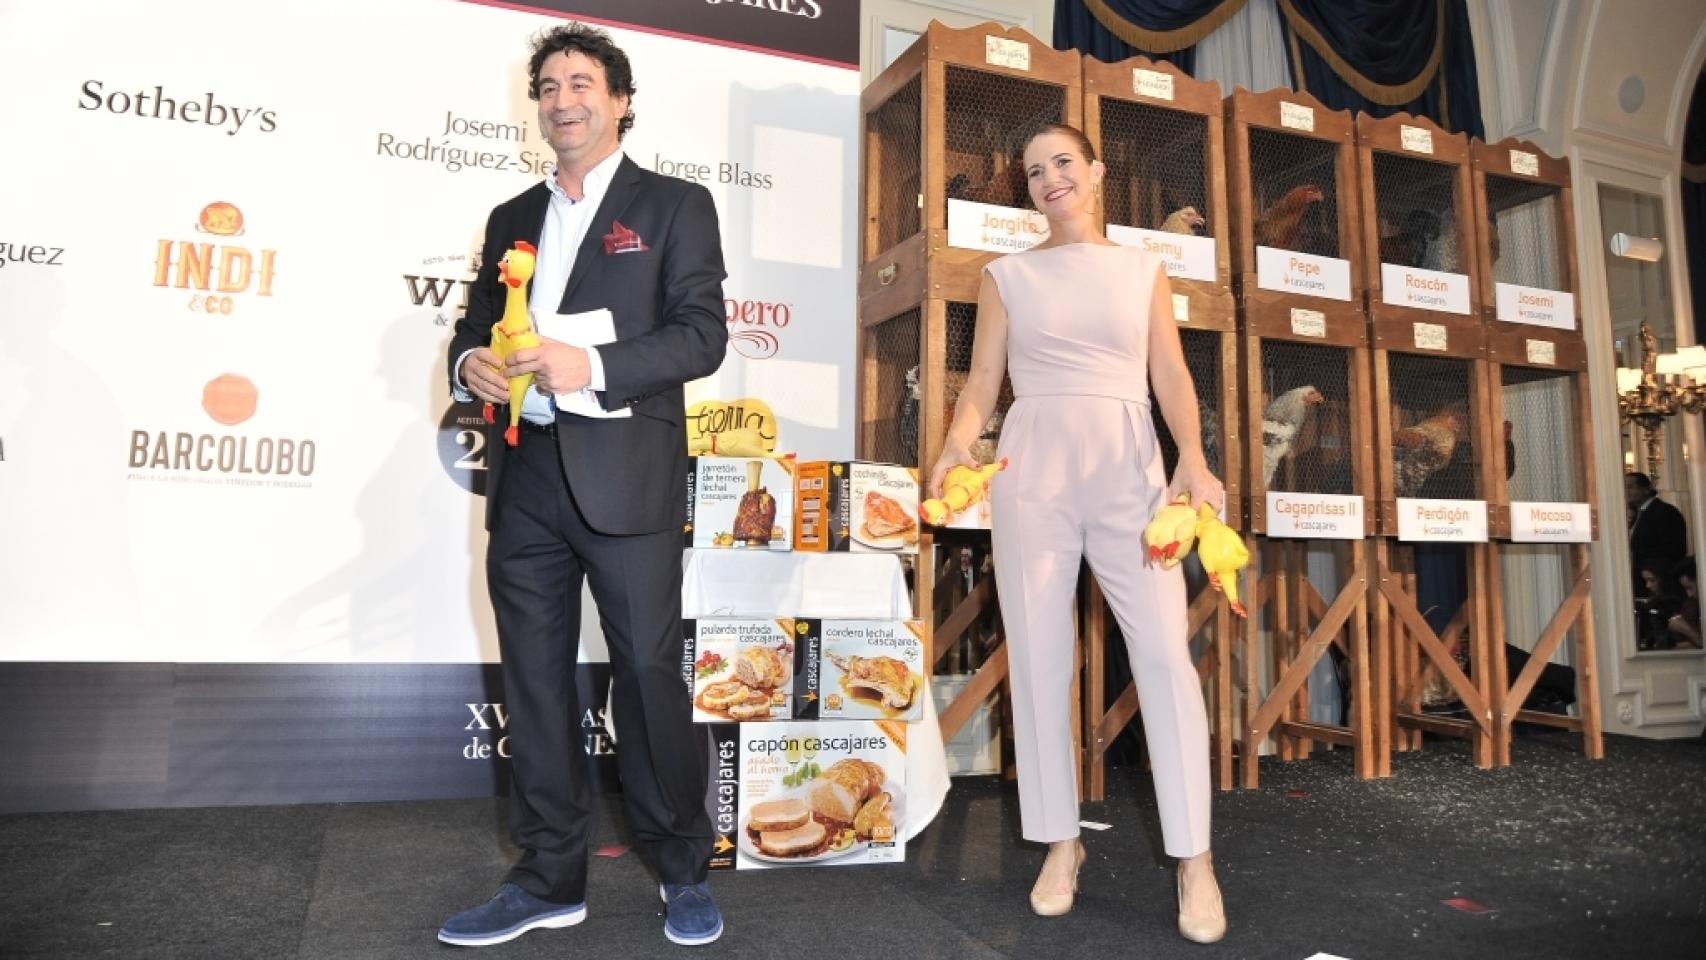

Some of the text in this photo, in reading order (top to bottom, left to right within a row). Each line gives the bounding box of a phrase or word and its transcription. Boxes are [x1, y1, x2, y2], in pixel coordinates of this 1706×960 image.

[78, 79, 278, 136] Sotheby's
[442, 111, 527, 142] Josemi
[718, 162, 774, 190] Blass
[1142, 237, 1183, 260] Samy
[152, 238, 277, 297] INDI
[1290, 257, 1321, 277] Pepe
[1405, 273, 1448, 292] Roscón
[1519, 291, 1553, 308] Josemi
[128, 429, 316, 477] BARCOLOBO
[1275, 498, 1345, 518] Cagaprisas
[1416, 506, 1470, 525] Perdigón
[700, 624, 772, 637] pularda trufada
[739, 634, 786, 644] cascajares
[826, 628, 894, 638] cordero lechal
[867, 637, 918, 648] cascajares
[807, 636, 820, 690] cascajares
[463, 736, 491, 759] de
[748, 734, 887, 756] capón cascajares
[716, 739, 739, 833] cascajares
